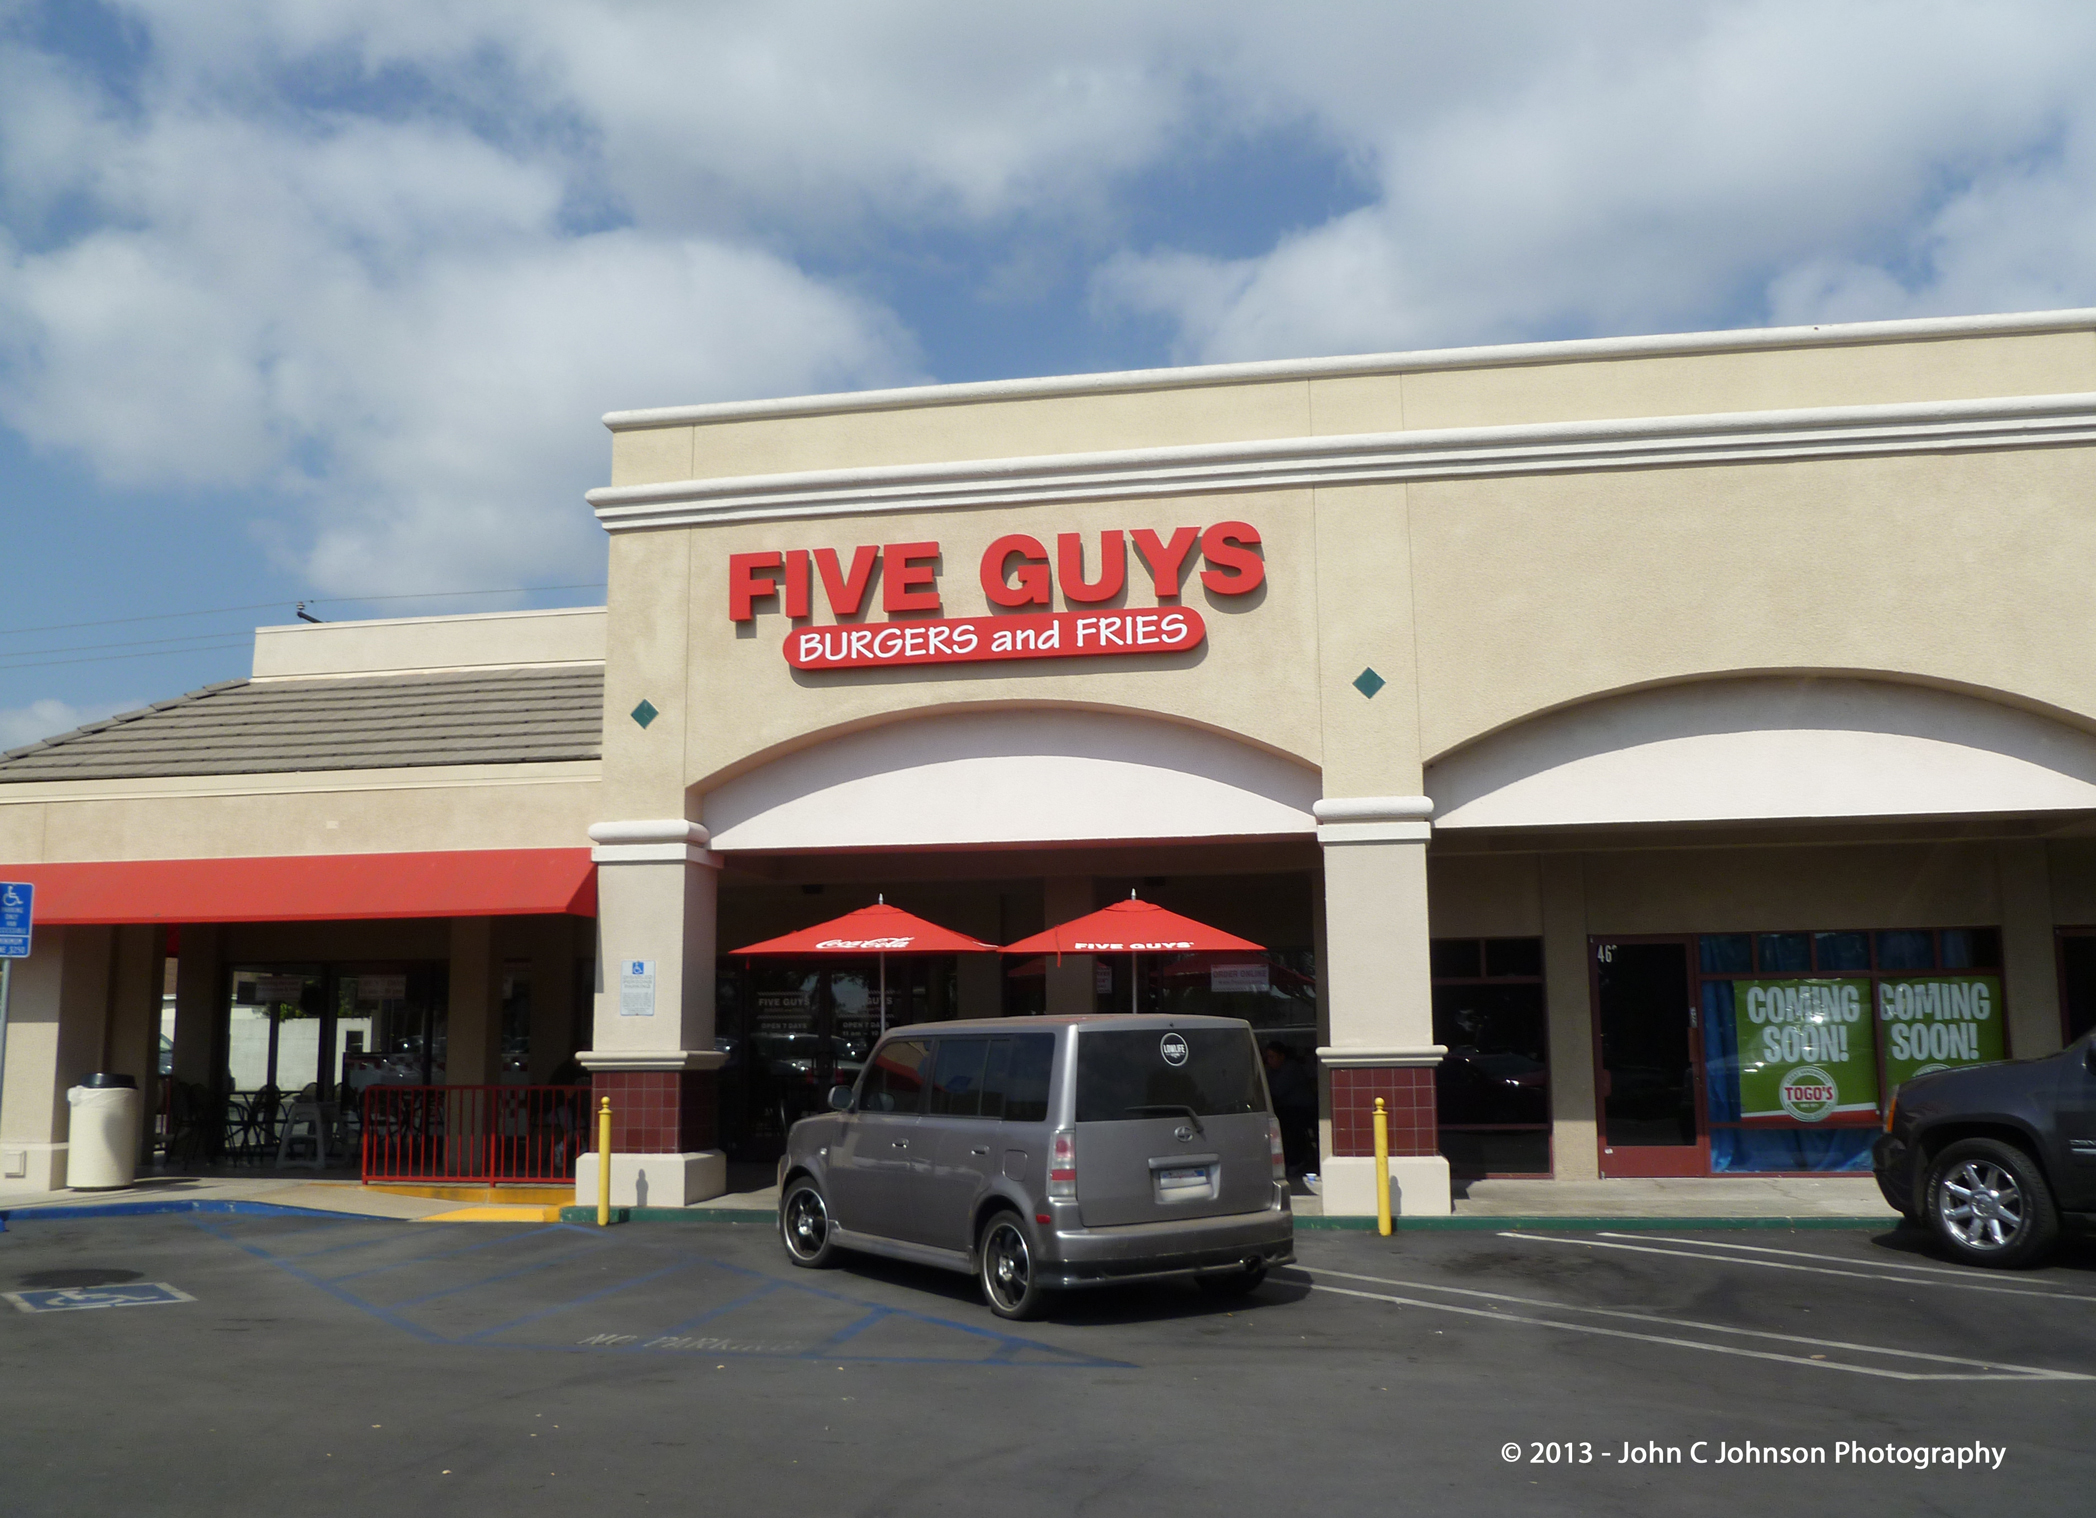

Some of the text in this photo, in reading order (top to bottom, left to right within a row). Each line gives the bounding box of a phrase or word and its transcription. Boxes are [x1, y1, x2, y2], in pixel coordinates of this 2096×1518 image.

[729, 520, 1266, 622] FIVE GUYS
[798, 613, 1188, 663] BURGERS and FRIES
[815, 937, 915, 948] Coca-Cola
[1074, 942, 1190, 950] FIVE GUYS
[1213, 970, 1237, 978] ORDER
[758, 998, 811, 1006] FIVE GUYS
[867, 997, 893, 1005] GUS
[1746, 985, 1860, 1024] COMING
[1879, 982, 1991, 1020] COMING
[870, 1021, 890, 1029] DAS
[1763, 1025, 1849, 1062] SOON!
[1891, 1022, 1980, 1060] SOON!
[1784, 1086, 1833, 1101] TOGO'S
